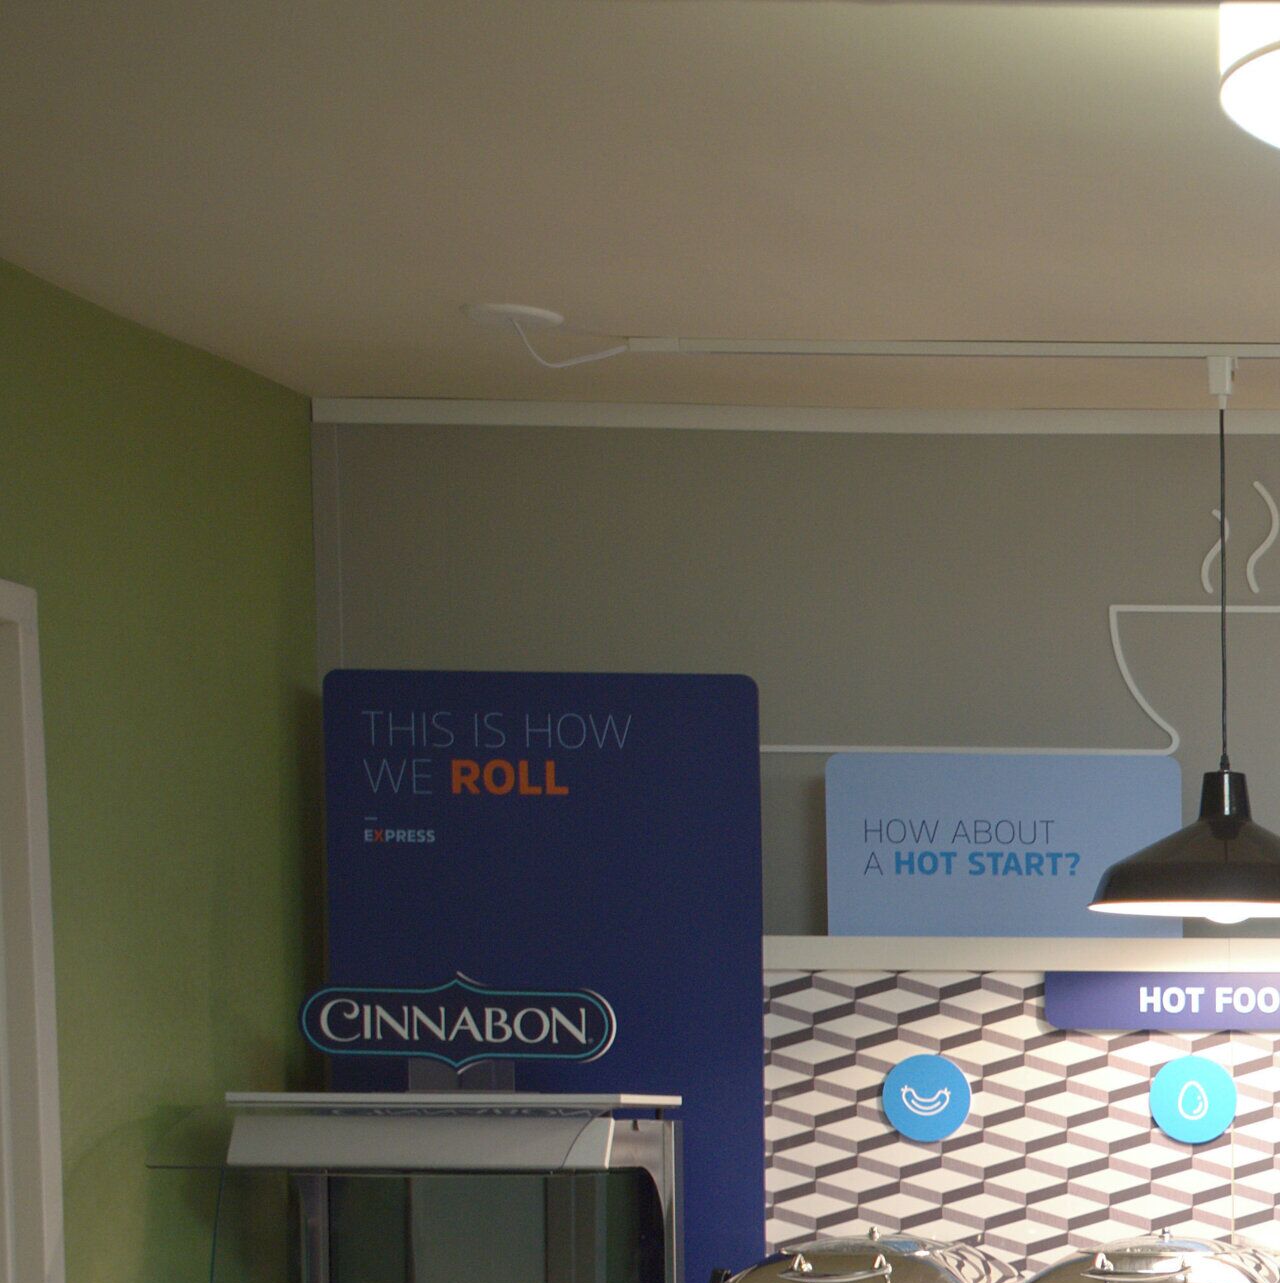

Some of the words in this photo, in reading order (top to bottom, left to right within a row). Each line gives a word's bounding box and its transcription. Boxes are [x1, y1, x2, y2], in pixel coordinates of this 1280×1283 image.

[362, 710, 455, 748] THIS
[474, 712, 506, 749] IS
[525, 713, 632, 750] HOW
[363, 758, 433, 795] WE
[451, 758, 569, 795] ROLL
[364, 828, 436, 843] EXPRESS
[864, 818, 938, 845] HOW
[951, 819, 1055, 845] ABOUT
[863, 851, 884, 876] A
[894, 851, 957, 876] HOT
[968, 851, 1081, 877] START?
[1139, 986, 1205, 1013] HOT
[320, 998, 588, 1045] CINNABON
